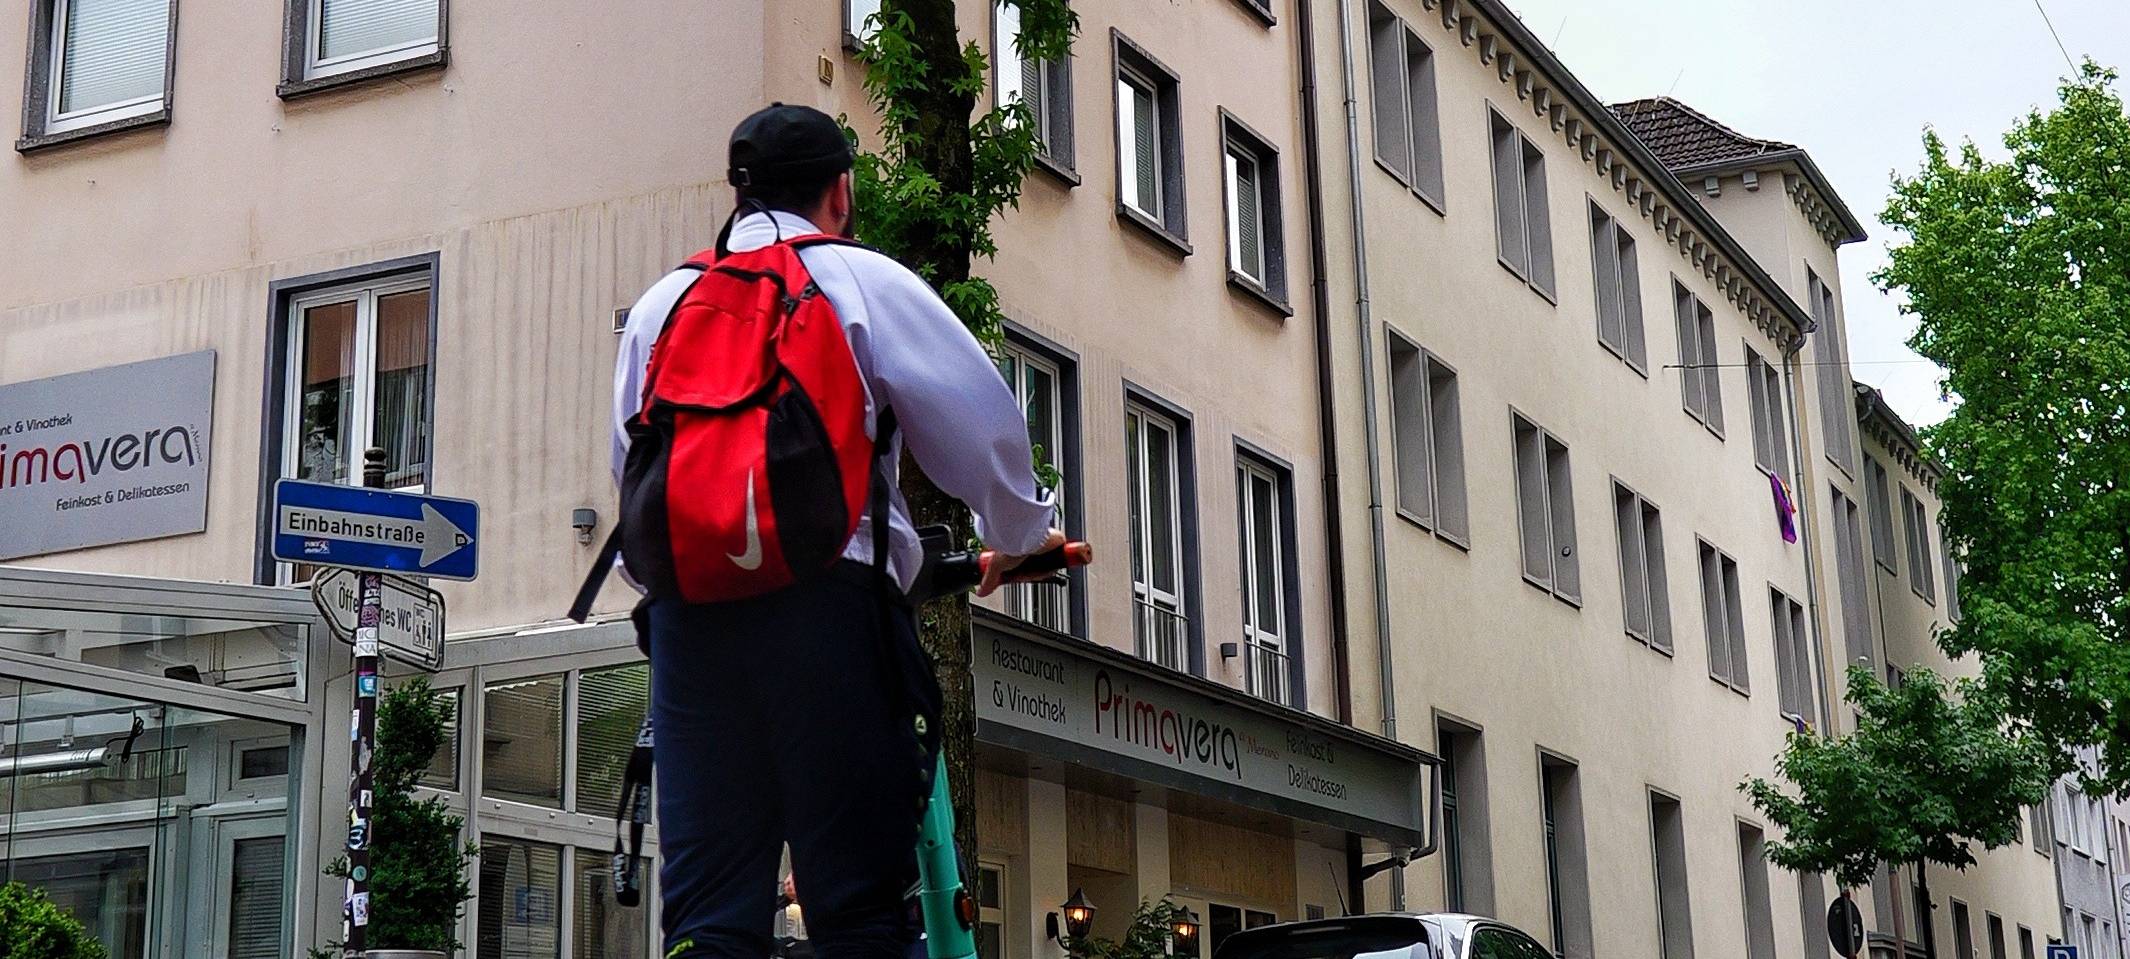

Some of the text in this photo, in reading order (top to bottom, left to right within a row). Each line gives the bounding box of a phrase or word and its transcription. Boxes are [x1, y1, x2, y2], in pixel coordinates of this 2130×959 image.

[15, 420, 23, 433] &
[26, 413, 72, 431] Vinothek
[56, 482, 189, 511] Feinkost & Delikatessen
[289, 512, 425, 543] Einbahnstraße
[338, 580, 396, 628] Öffehes
[397, 607, 411, 632] WC
[992, 639, 1064, 684] Restaurant
[993, 680, 1066, 724] & Vinothek
[1094, 669, 1241, 779] Primavera
[1286, 730, 1326, 761] Feinkost
[1287, 763, 1347, 800] Delikatessen
